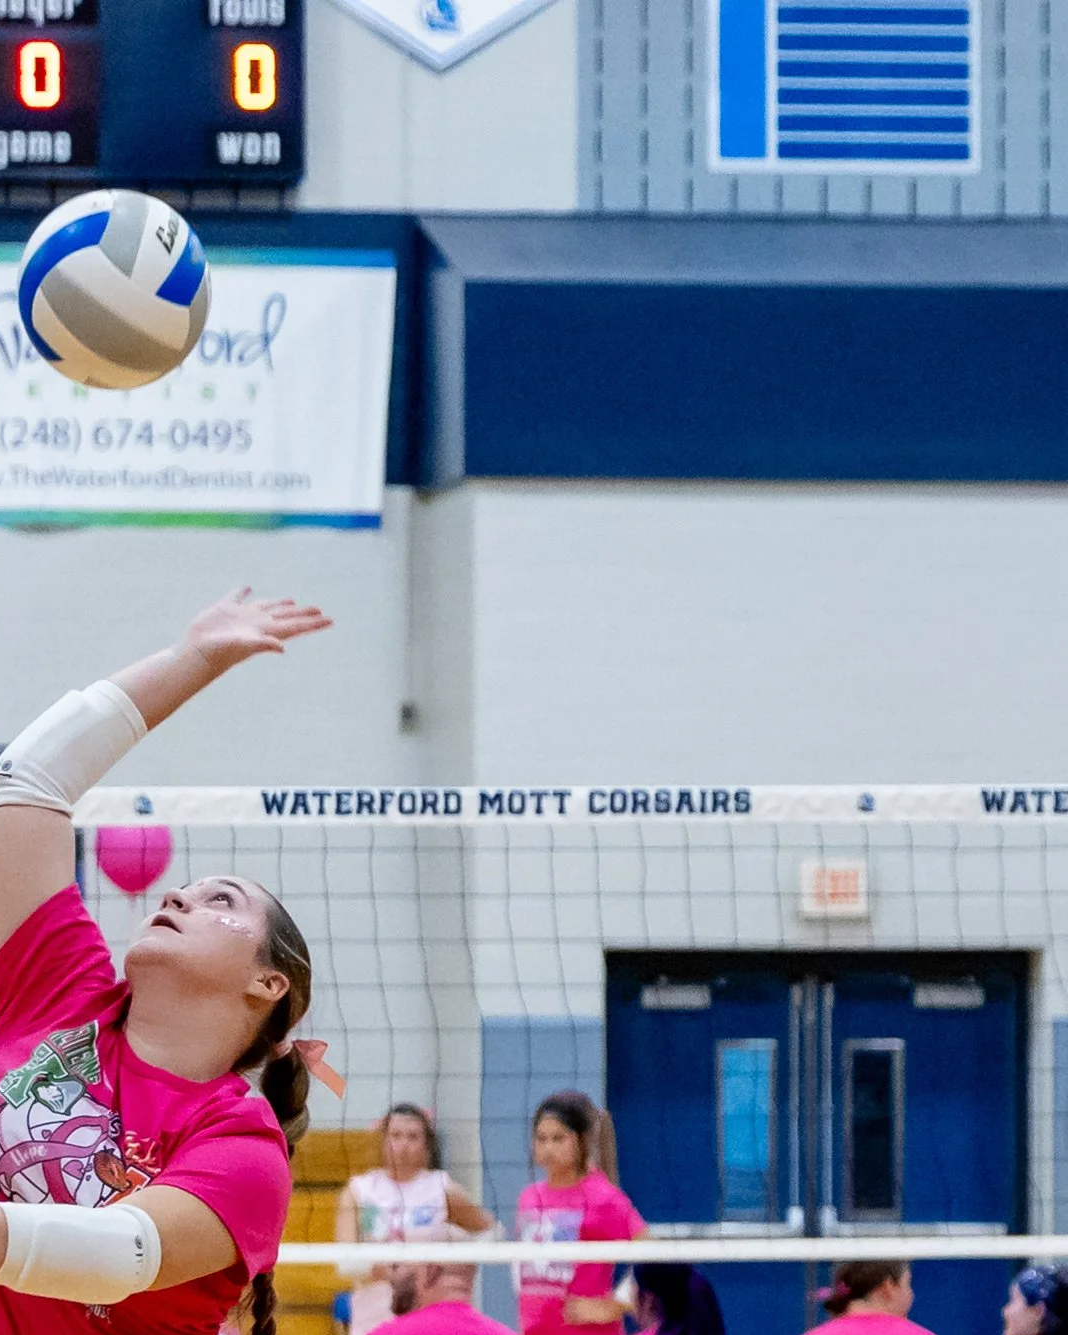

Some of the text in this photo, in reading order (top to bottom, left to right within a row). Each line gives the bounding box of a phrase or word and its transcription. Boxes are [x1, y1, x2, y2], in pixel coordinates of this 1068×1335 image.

[17, 40, 62, 110] 0
[233, 42, 277, 112] 0
[216, 131, 281, 165] won
[92, 417, 254, 454] 674-0495
[262, 788, 752, 816] WATERFORD MOTT CORSAIRS
[980, 789, 1068, 813] WATE
